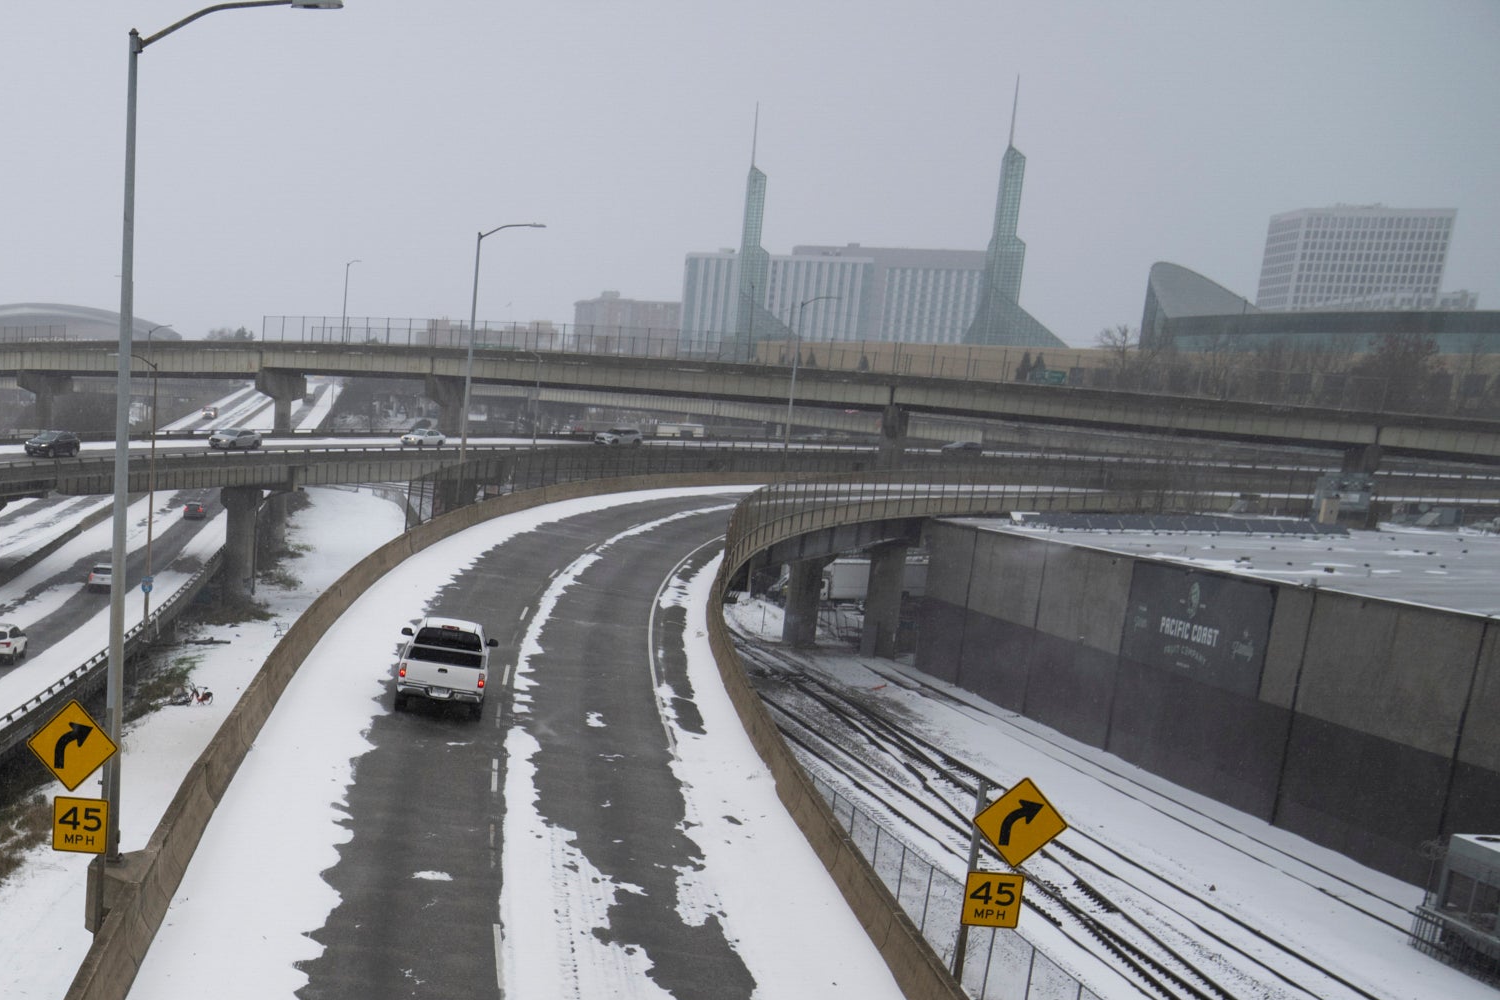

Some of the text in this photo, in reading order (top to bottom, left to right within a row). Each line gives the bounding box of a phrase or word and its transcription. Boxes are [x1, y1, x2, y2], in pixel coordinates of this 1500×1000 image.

[1159, 616, 1191, 641] PACIFIC
[1191, 624, 1219, 647] COAST
[58, 806, 102, 832] 45
[64, 834, 94, 846] MPH
[969, 881, 1016, 907] 45
[974, 908, 1006, 920] MPH
